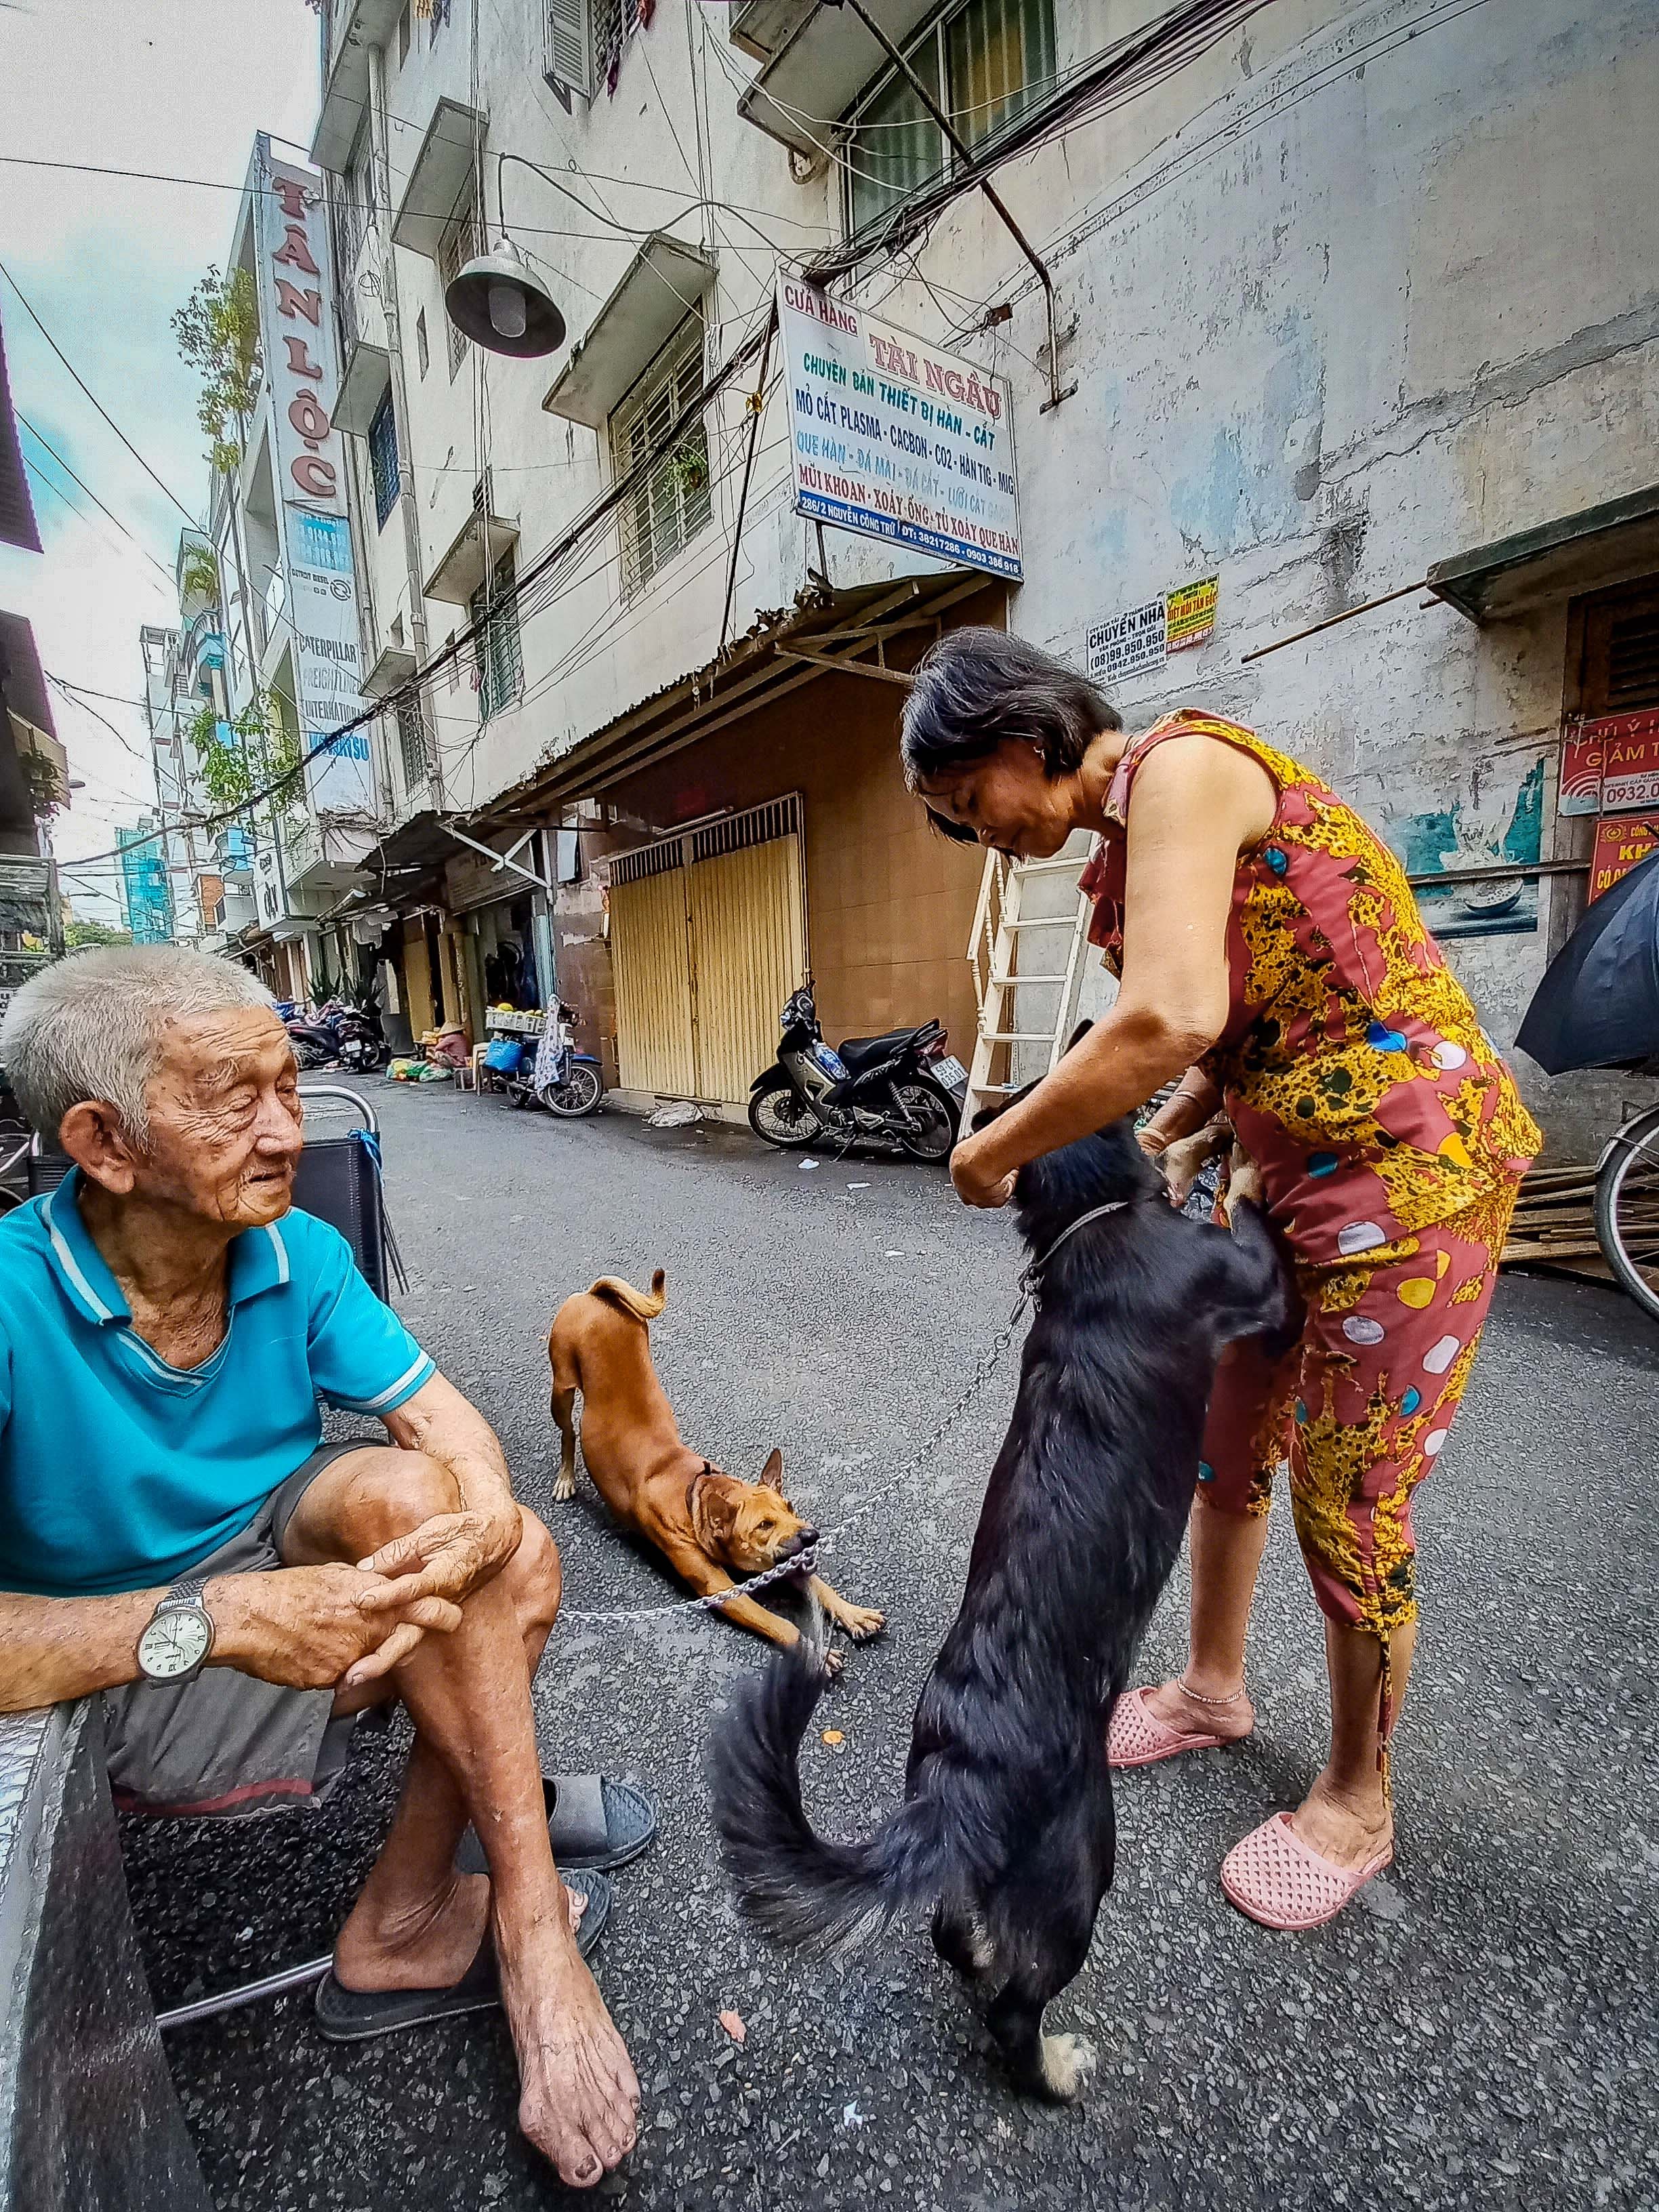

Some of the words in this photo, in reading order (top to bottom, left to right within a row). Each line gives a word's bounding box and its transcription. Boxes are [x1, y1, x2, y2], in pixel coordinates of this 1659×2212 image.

[272, 176, 322, 327] TÂN
[785, 285, 815, 316] CỬA
[819, 300, 858, 335] HÀNG
[868, 332, 919, 384] TÀI
[282, 334, 337, 497] LỘC
[804, 352, 846, 386] CHUYÊN
[852, 369, 874, 397] BÁN
[879, 382, 918, 415] THIẾT
[920, 401, 933, 427] BỊ
[937, 405, 962, 436] HÀN
[974, 419, 995, 451] CẮT
[795, 383, 813, 416] MỎ
[817, 391, 837, 425] CẮT
[840, 405, 882, 441] PLASMA
[890, 425, 928, 459] CACBON
[935, 444, 952, 470] CO2
[959, 452, 977, 481] HÀN
[978, 462, 992, 487] TIG
[998, 471, 1015, 495] MIG
[796, 430, 819, 456] QUE
[821, 436, 846, 464] HÀN
[857, 448, 872, 473] ĐÁ
[799, 462, 822, 490] MŨI
[824, 472, 866, 504] KHOAN
[907, 494, 929, 526] ỐNG
[979, 527, 998, 548] QUE
[999, 530, 1019, 555] HÀN
[802, 497, 826, 514] 286/2
[827, 504, 859, 525] NGUYỄN
[860, 513, 880, 532] CÔNG
[966, 548, 987, 563] 0903
[299, 636, 357, 663] CATERPILLAR
[1089, 613, 1136, 649] CHUYỂN
[1139, 601, 1165, 628] NHÀ
[1586, 743, 1645, 766] GẢM
[1597, 865, 1612, 889] CÓ
[1618, 843, 1658, 861] KH
